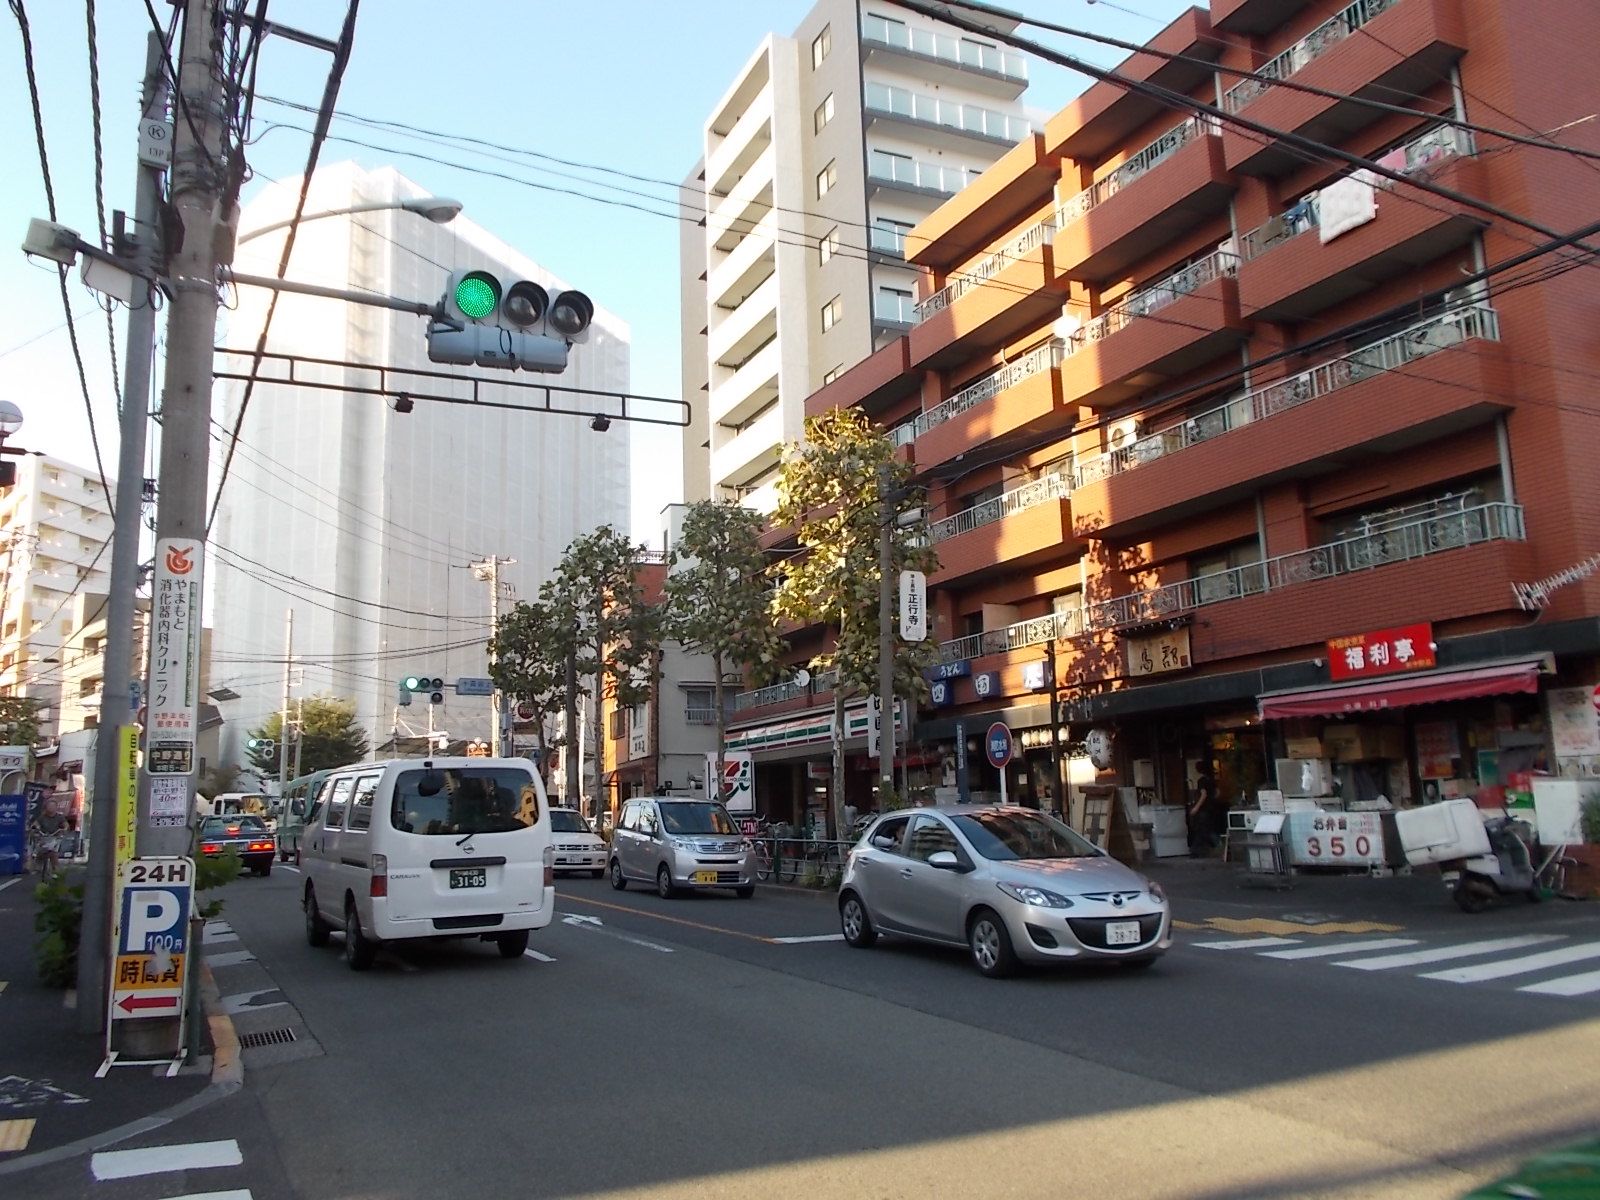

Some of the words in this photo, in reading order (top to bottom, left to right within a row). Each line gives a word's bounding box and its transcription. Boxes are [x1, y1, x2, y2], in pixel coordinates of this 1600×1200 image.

[173, 579, 187, 631] やまもと
[907, 593, 919, 625] 正行寺
[156, 578, 173, 707] 消化器内科クリニック
[1345, 638, 1416, 670] 福利亭
[940, 663, 961, 677] うどん
[151, 748, 191, 761] 中野通り
[743, 822, 757, 834] ATM
[1313, 815, 1348, 832] お弁当
[1307, 835, 1371, 857] 350
[130, 864, 187, 883] 24H
[457, 875, 485, 888] 31-05
[126, 889, 181, 952] P
[147, 934, 183, 951] 100円
[120, 958, 180, 985] 時間貸
